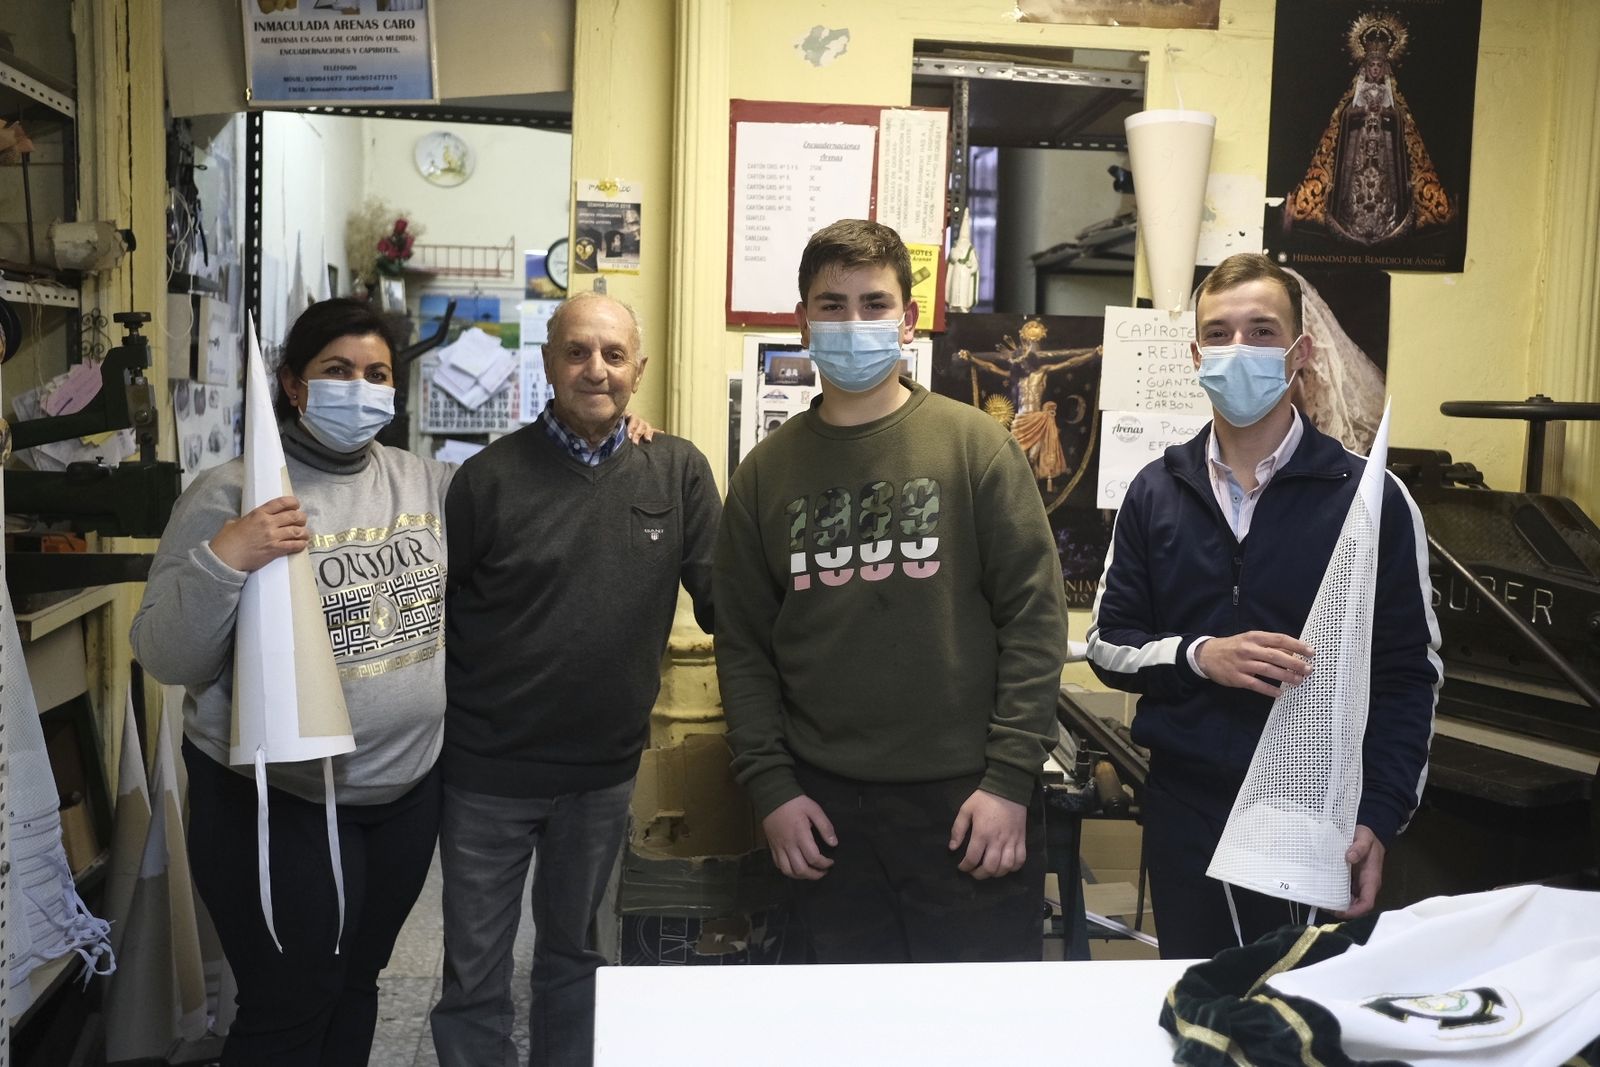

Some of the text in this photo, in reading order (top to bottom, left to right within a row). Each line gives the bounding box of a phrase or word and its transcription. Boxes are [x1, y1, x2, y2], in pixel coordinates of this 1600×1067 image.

[254, 18, 415, 32] INMACULADA ARENAS CARO
[1293, 254, 1346, 263] HERMANDAD
[1349, 256, 1362, 264] DEL
[1365, 256, 1400, 264] REMEDIO
[1116, 316, 1195, 339] CAPIROTE
[1148, 364, 1197, 375] CARTO
[1146, 378, 1200, 388] GUANTE
[1145, 390, 1205, 400] INCIENSO
[1146, 400, 1194, 410] CARBON
[1112, 424, 1143, 434] Arenas
[316, 536, 434, 588] ONJOUR
[1280, 882, 1289, 890] 70
